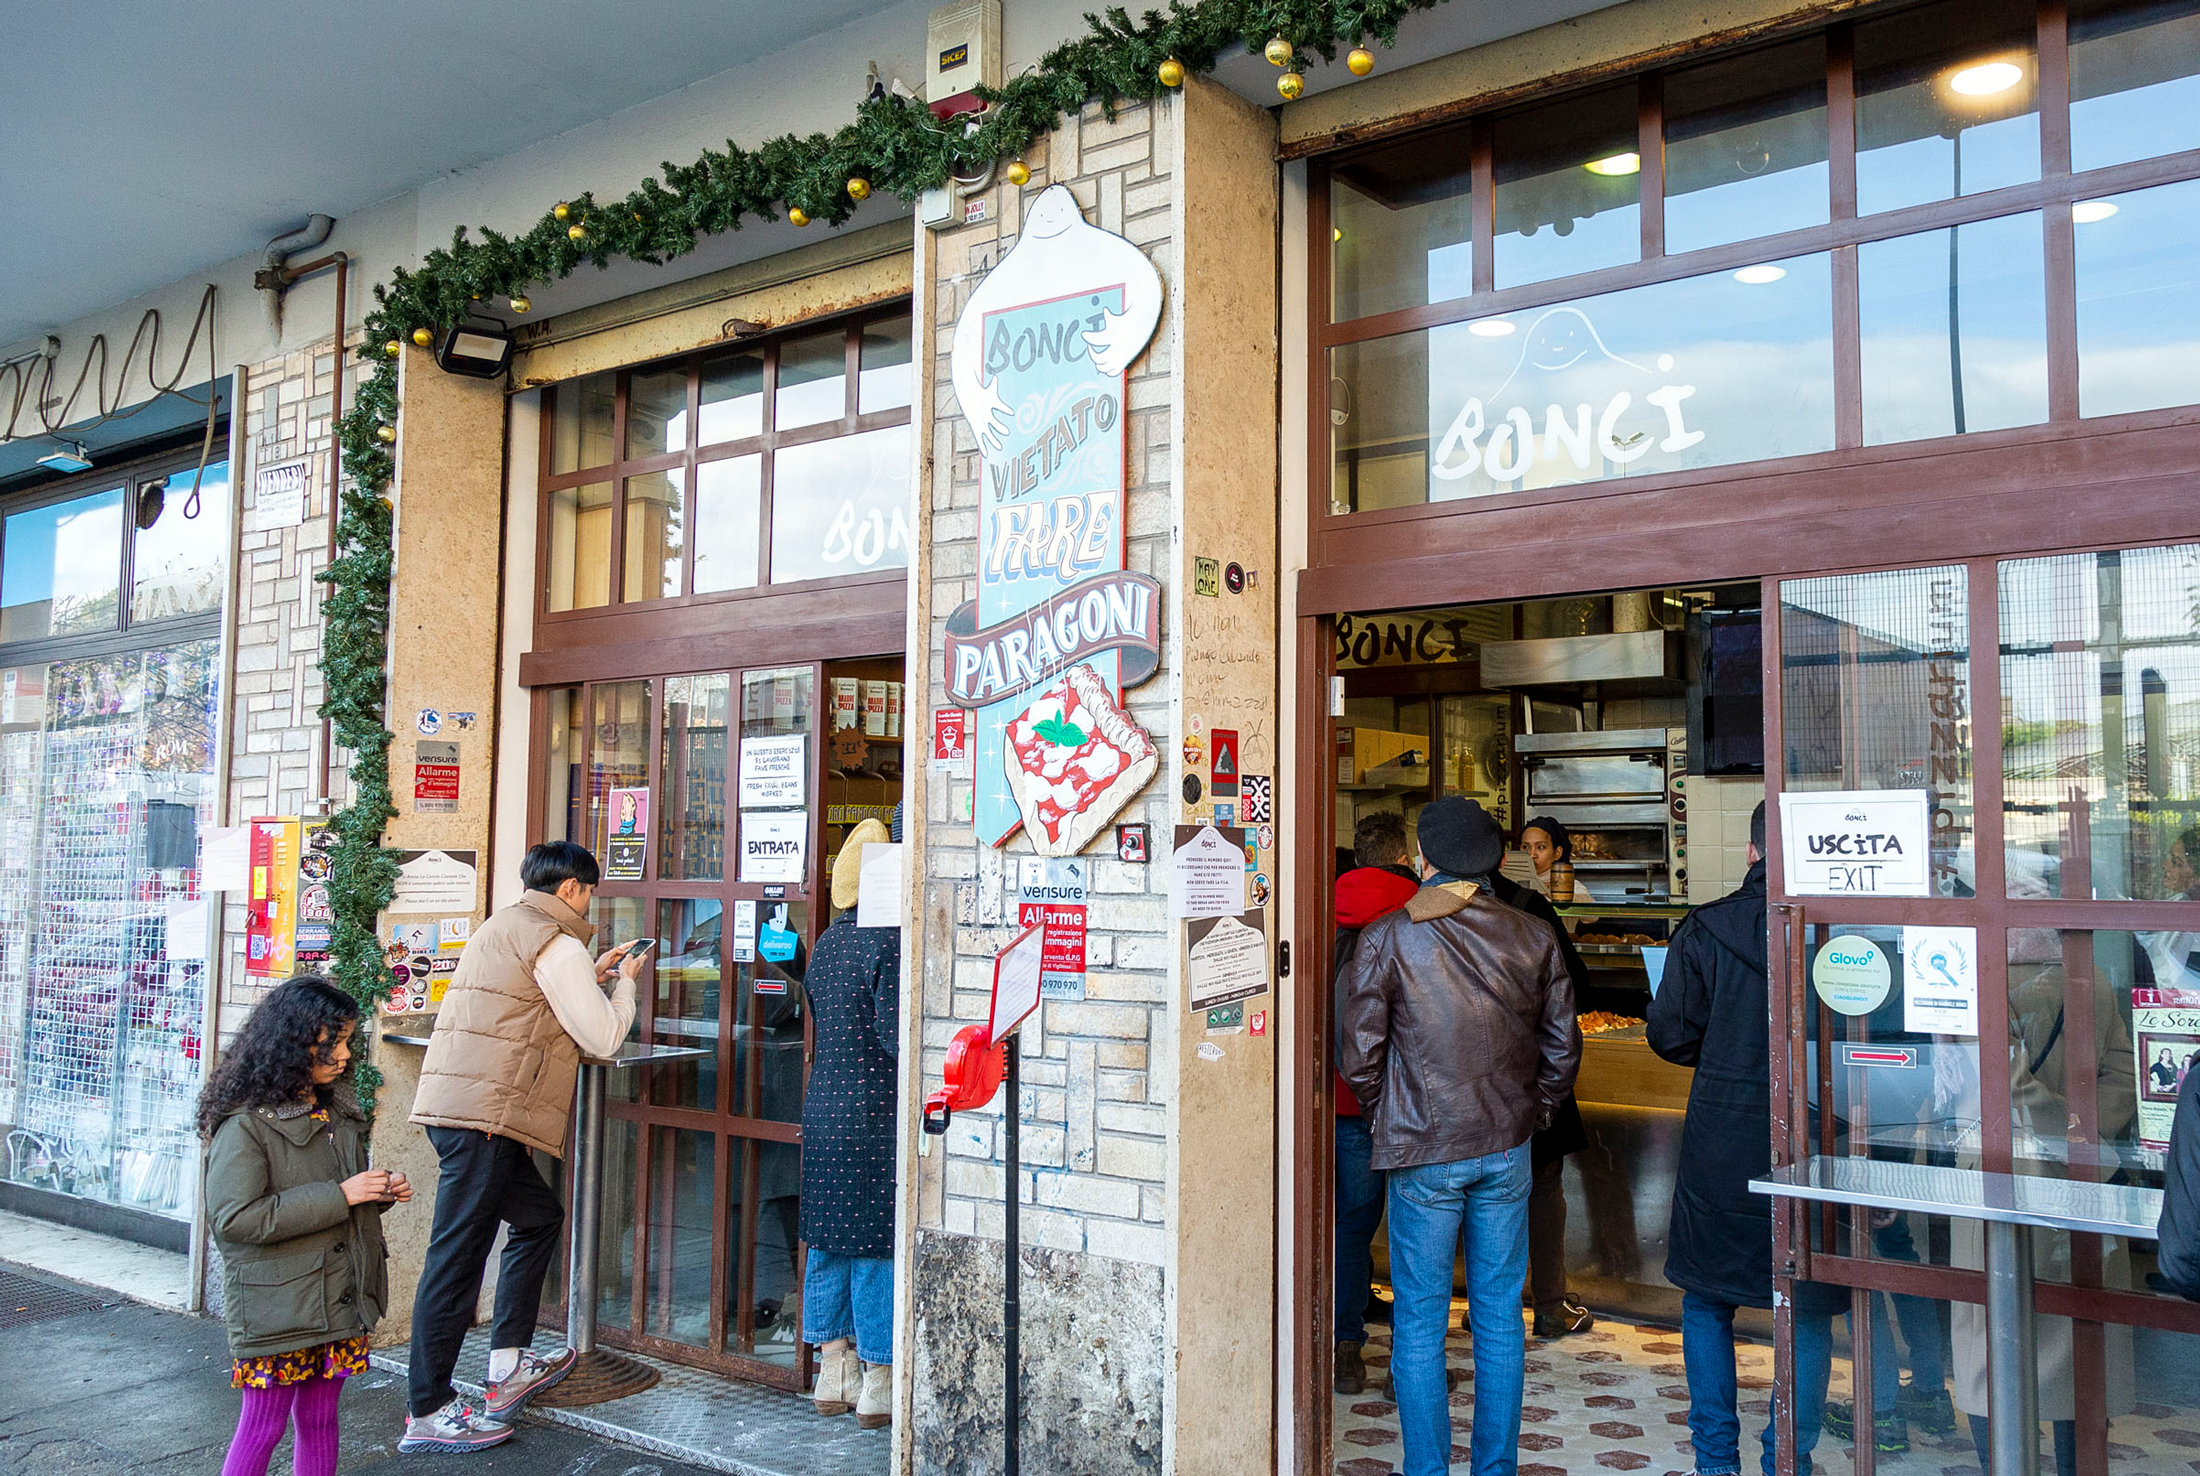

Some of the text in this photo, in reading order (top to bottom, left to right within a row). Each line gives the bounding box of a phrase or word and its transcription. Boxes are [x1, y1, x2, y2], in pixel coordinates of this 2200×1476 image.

[941, 48, 966, 66] SICEP
[1431, 353, 1706, 482] BONCI
[990, 393, 1118, 503] VIETATO
[986, 489, 1118, 584] FARE
[952, 581, 1152, 700] PARAGONI
[1336, 614, 1473, 666] BONCI
[838, 703, 854, 711] PIZZA
[867, 704, 884, 713] PIZZA
[418, 754, 458, 764] verisure
[418, 766, 458, 777] Allarme
[846, 806, 884, 822] PANDORO
[748, 840, 800, 855] ENTRATA
[1808, 833, 1904, 856] USCITA
[1829, 865, 1883, 892] EXIT
[1023, 885, 1083, 899] verisure
[1023, 906, 1083, 926] Allarme
[1047, 928, 1082, 937] registrazione
[762, 940, 793, 950] deliveroo
[1829, 952, 1868, 966] Glovo
[1048, 980, 1062, 989] 970
[1063, 981, 1078, 990] 970
[2138, 1010, 2160, 1028] Le
